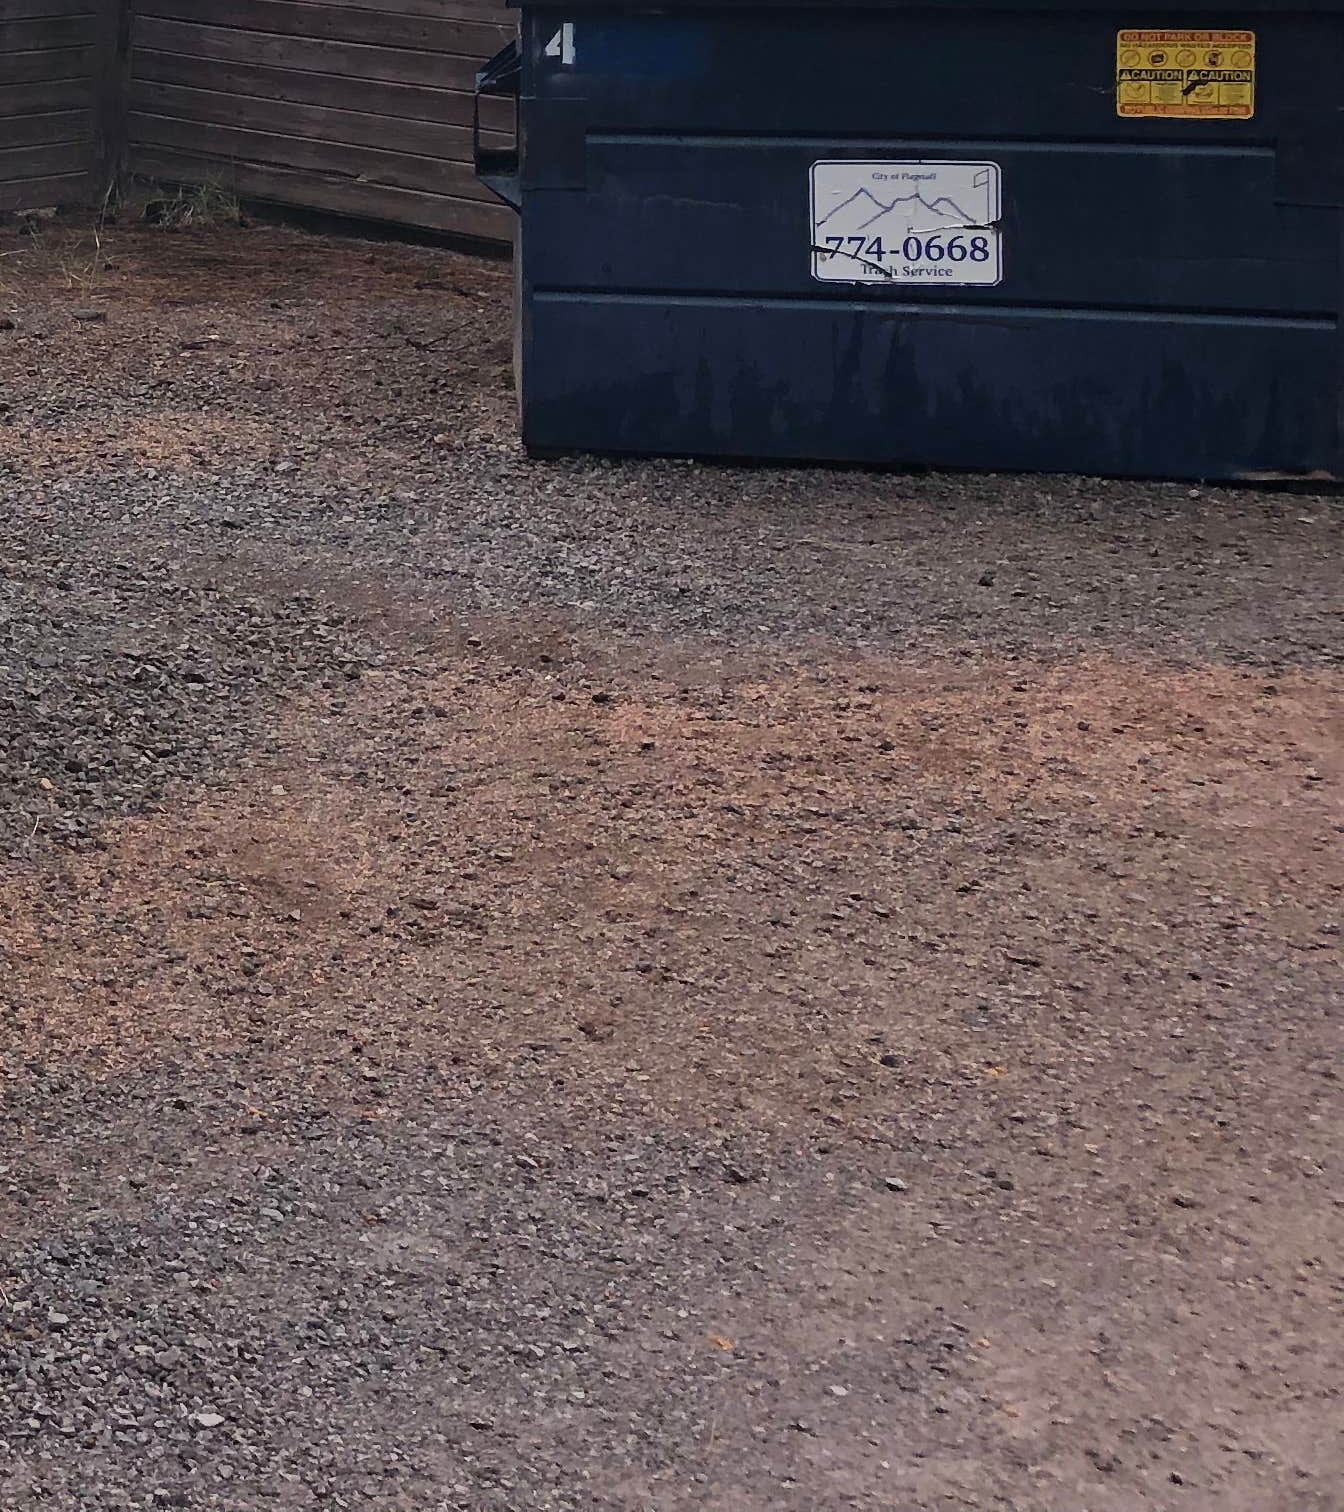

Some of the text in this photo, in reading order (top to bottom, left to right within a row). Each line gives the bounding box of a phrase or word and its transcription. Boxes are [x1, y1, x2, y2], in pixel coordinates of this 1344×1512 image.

[1141, 32, 1162, 41] NOT
[1164, 32, 1192, 41] PARK
[1194, 33, 1210, 41] OR
[1212, 33, 1248, 42] BLOCK
[545, 22, 576, 64] 4
[1131, 70, 1182, 80] CAUTION
[1200, 70, 1250, 81] CAUTION
[872, 172, 888, 181] City
[890, 172, 899, 180] of
[825, 235, 990, 262] 774-0668
[902, 264, 953, 277] Service
